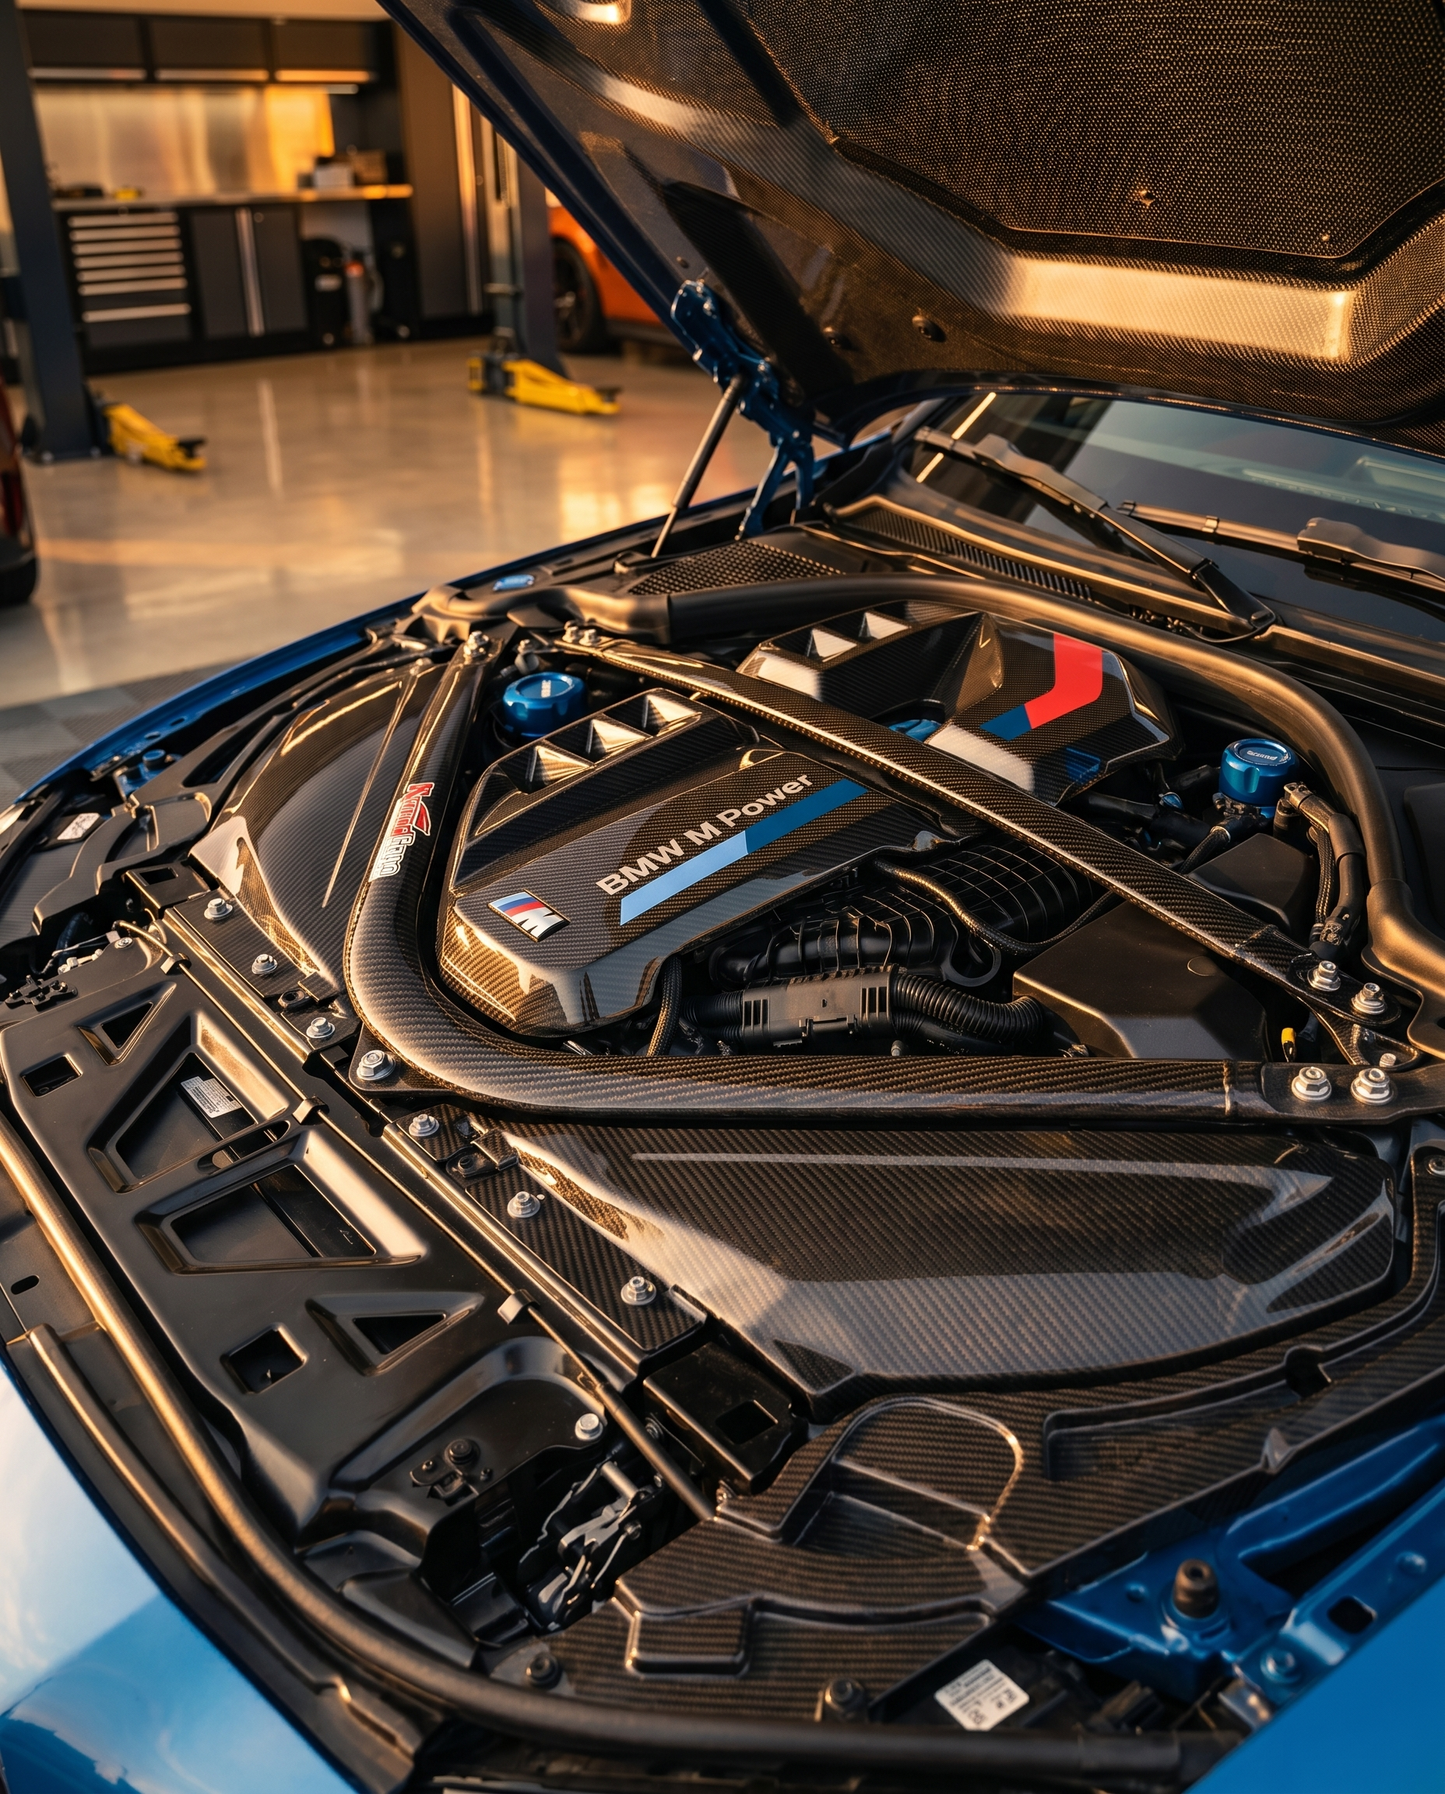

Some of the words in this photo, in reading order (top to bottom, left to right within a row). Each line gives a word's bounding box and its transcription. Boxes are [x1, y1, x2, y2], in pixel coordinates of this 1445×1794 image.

[596, 838, 685, 896] BMW
[683, 821, 722, 846] M
[706, 774, 813, 828] Power
